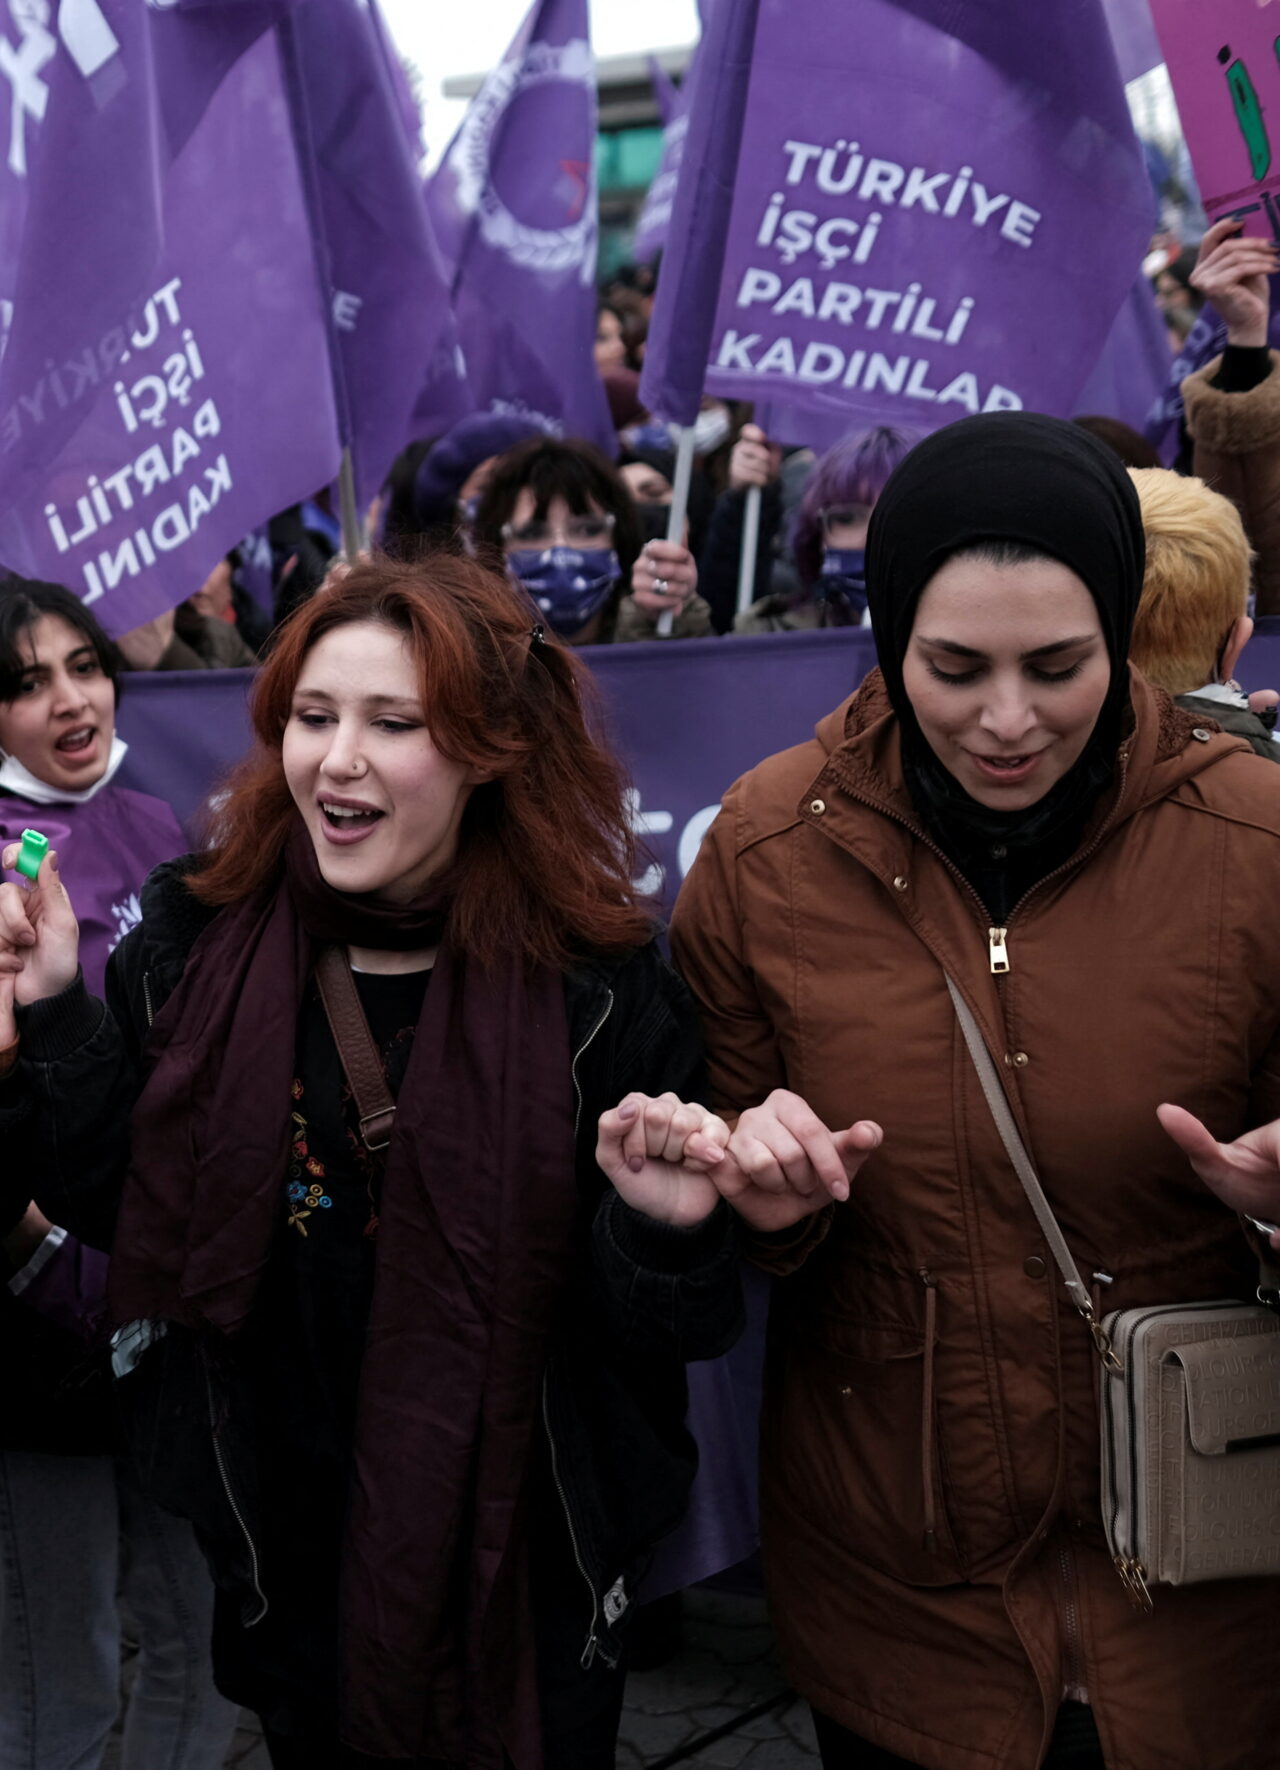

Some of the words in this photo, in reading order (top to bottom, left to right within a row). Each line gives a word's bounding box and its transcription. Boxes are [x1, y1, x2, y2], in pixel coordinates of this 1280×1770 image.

[756, 192, 882, 270] İŞÇİ
[783, 139, 1041, 248] TÜRKİYE
[737, 266, 975, 345] PARTİLİ
